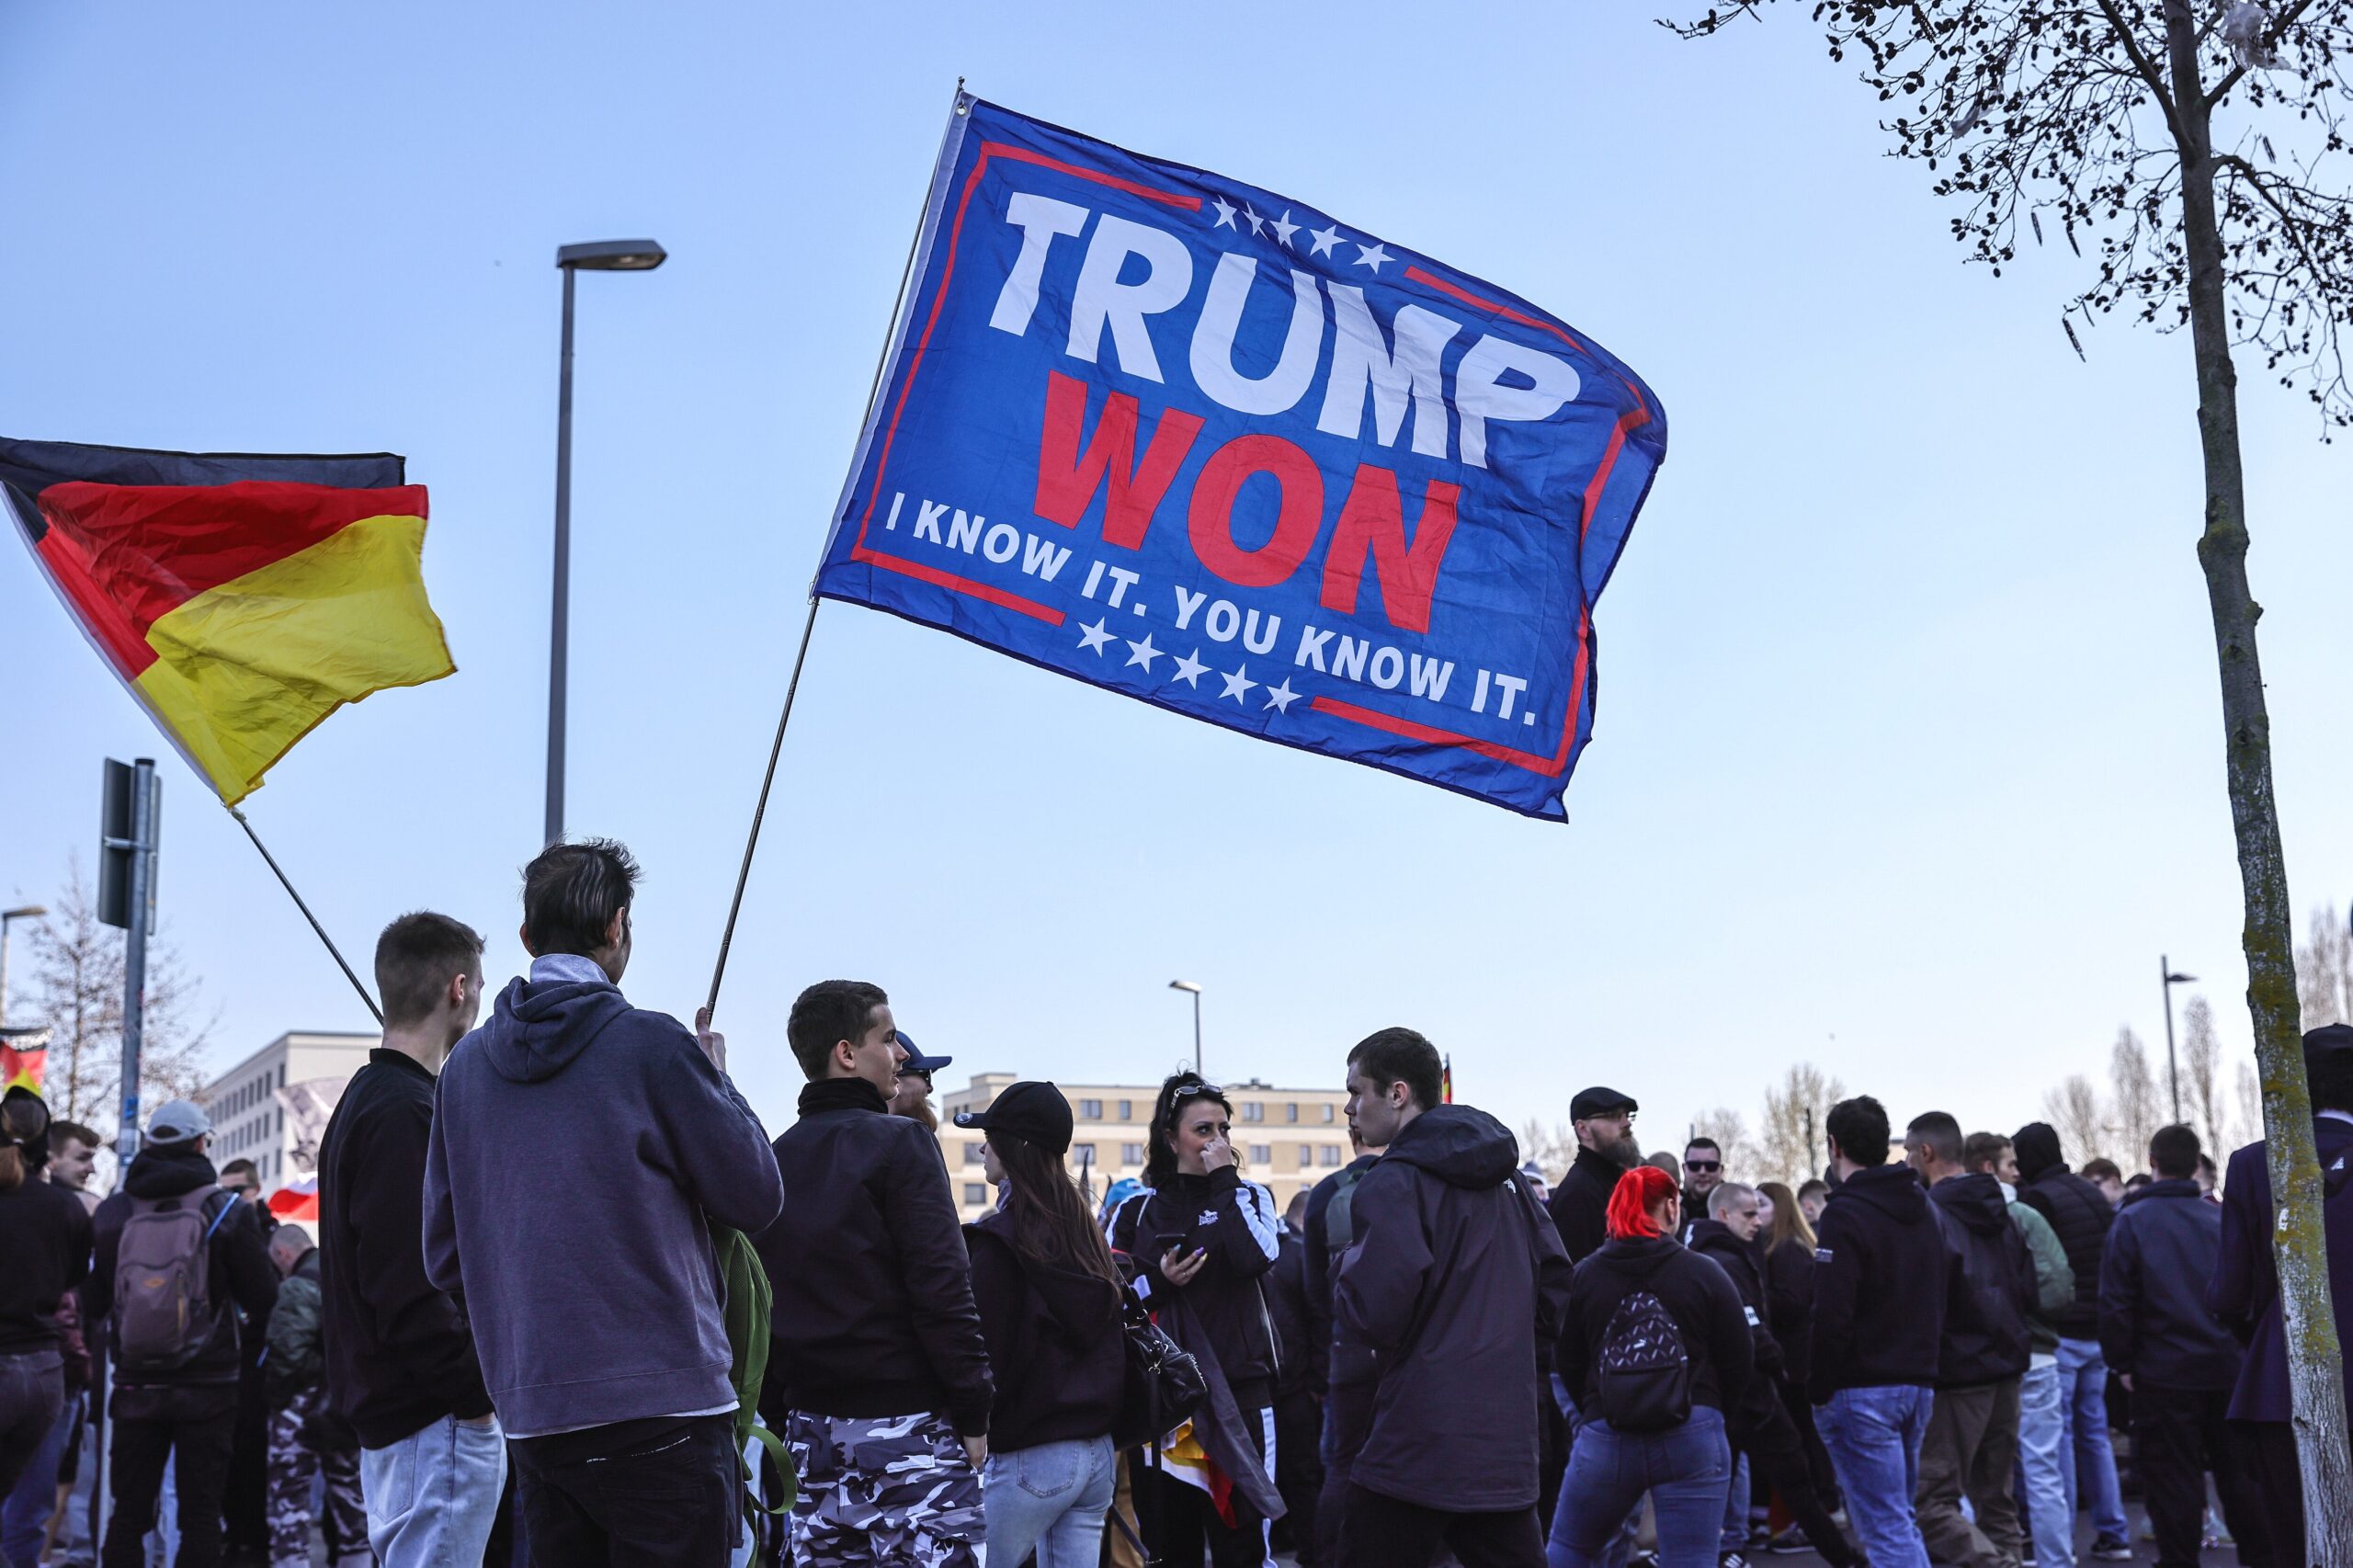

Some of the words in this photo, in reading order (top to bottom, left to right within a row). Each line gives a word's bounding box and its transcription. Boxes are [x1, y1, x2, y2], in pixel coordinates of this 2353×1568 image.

[989, 191, 1581, 470] TRUMP
[885, 492, 905, 531] I
[913, 499, 1073, 583] KNOW
[1081, 560, 1147, 617] IT.
[1175, 585, 1281, 654] YOU
[1294, 624, 1455, 702] KNOW
[1471, 668, 1536, 726] IT.
[1034, 370, 1461, 634] WON
